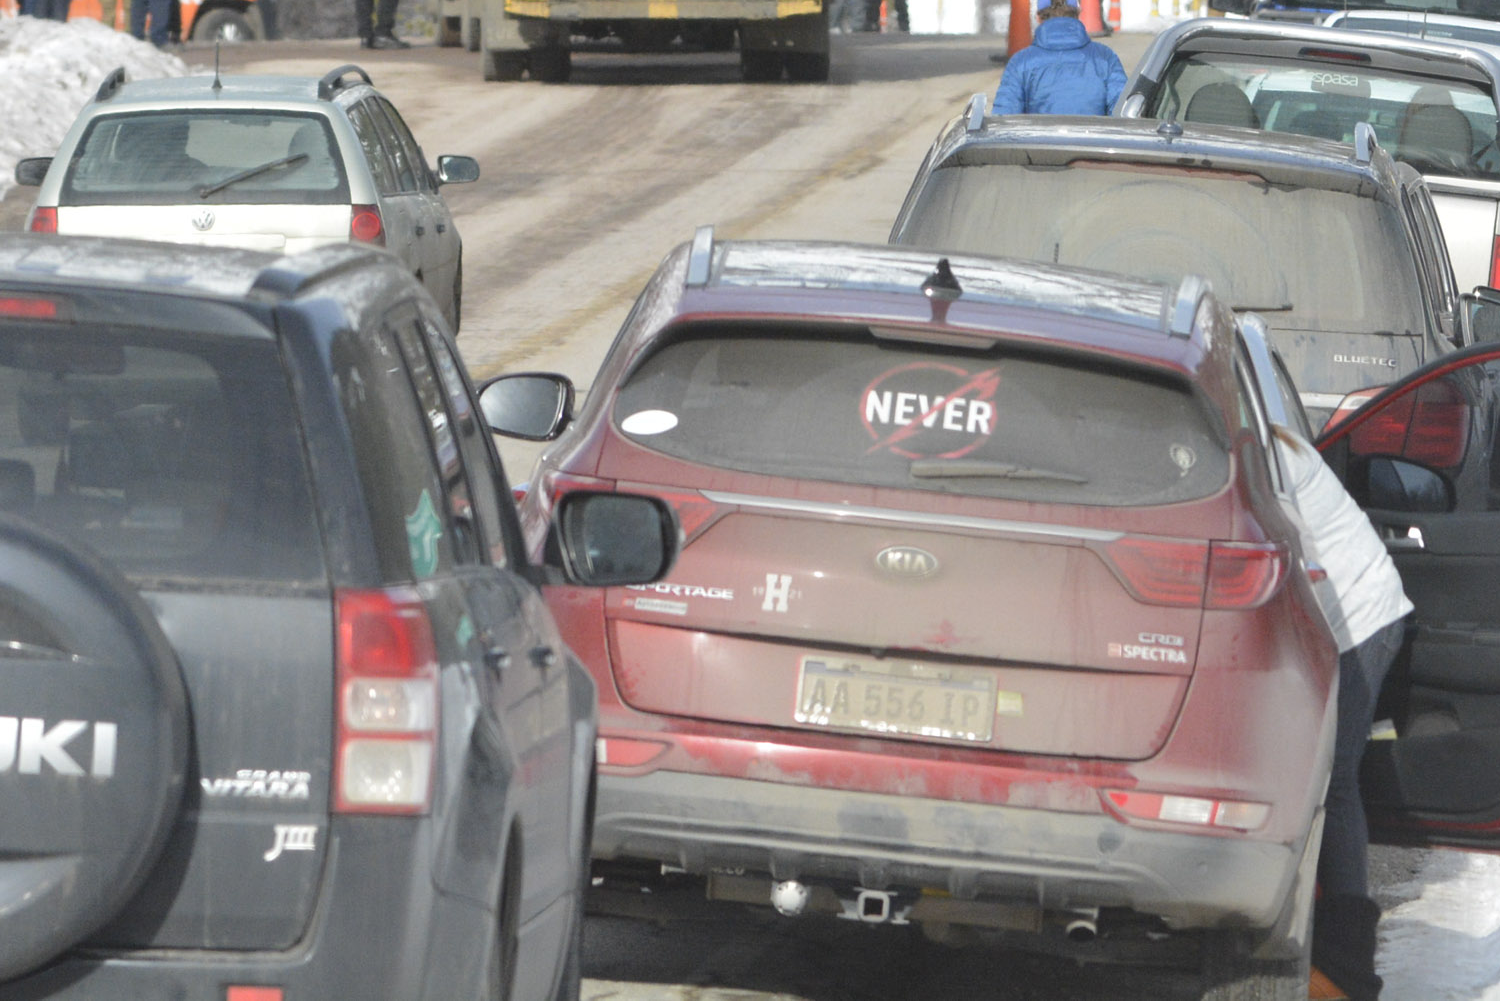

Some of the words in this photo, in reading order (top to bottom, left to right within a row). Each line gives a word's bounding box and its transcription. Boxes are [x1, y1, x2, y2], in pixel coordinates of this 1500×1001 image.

[1333, 353, 1398, 369] BLUETEC
[865, 389, 994, 436] NEVER
[887, 551, 927, 573] KIA
[1122, 643, 1188, 664] SPECTRA
[808, 677, 849, 716] AA
[862, 684, 926, 722] 556
[199, 777, 311, 800] VITARA
